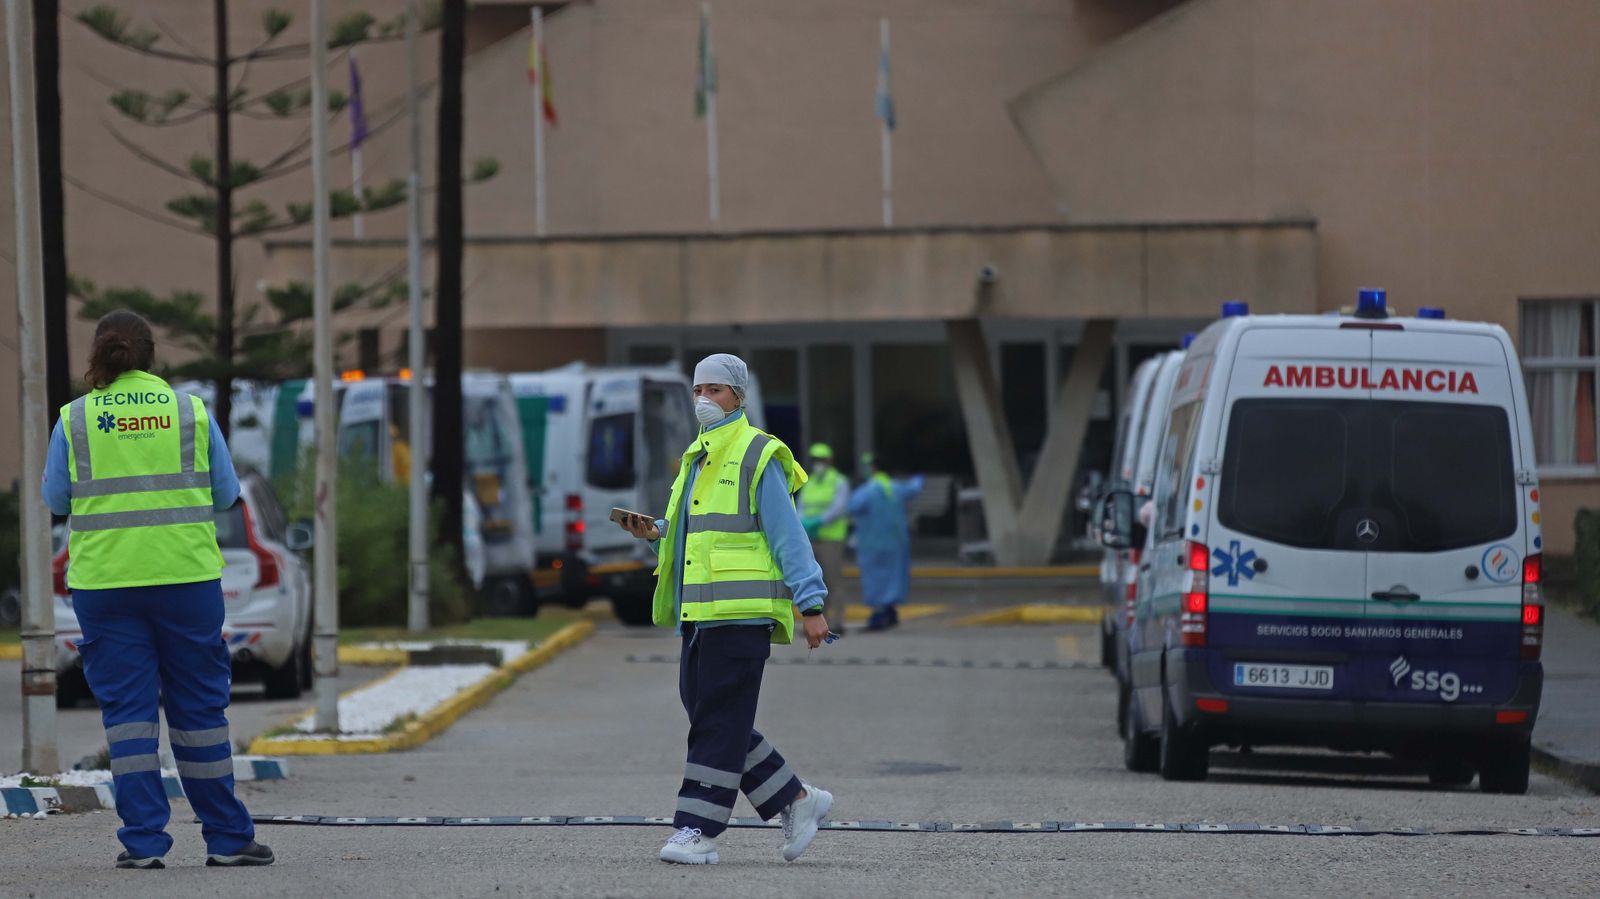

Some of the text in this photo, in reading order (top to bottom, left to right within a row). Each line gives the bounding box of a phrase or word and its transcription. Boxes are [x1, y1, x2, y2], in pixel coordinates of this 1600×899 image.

[1263, 365, 1479, 394] AMBULANCIA
[93, 392, 170, 406] TÉCNICO
[117, 416, 171, 431] samu
[118, 432, 155, 440] emergencias
[1256, 624, 1463, 640] SERVICIOS SOCIO SANITARIOS GENERALES
[1248, 667, 1329, 685] 6613 JJD
